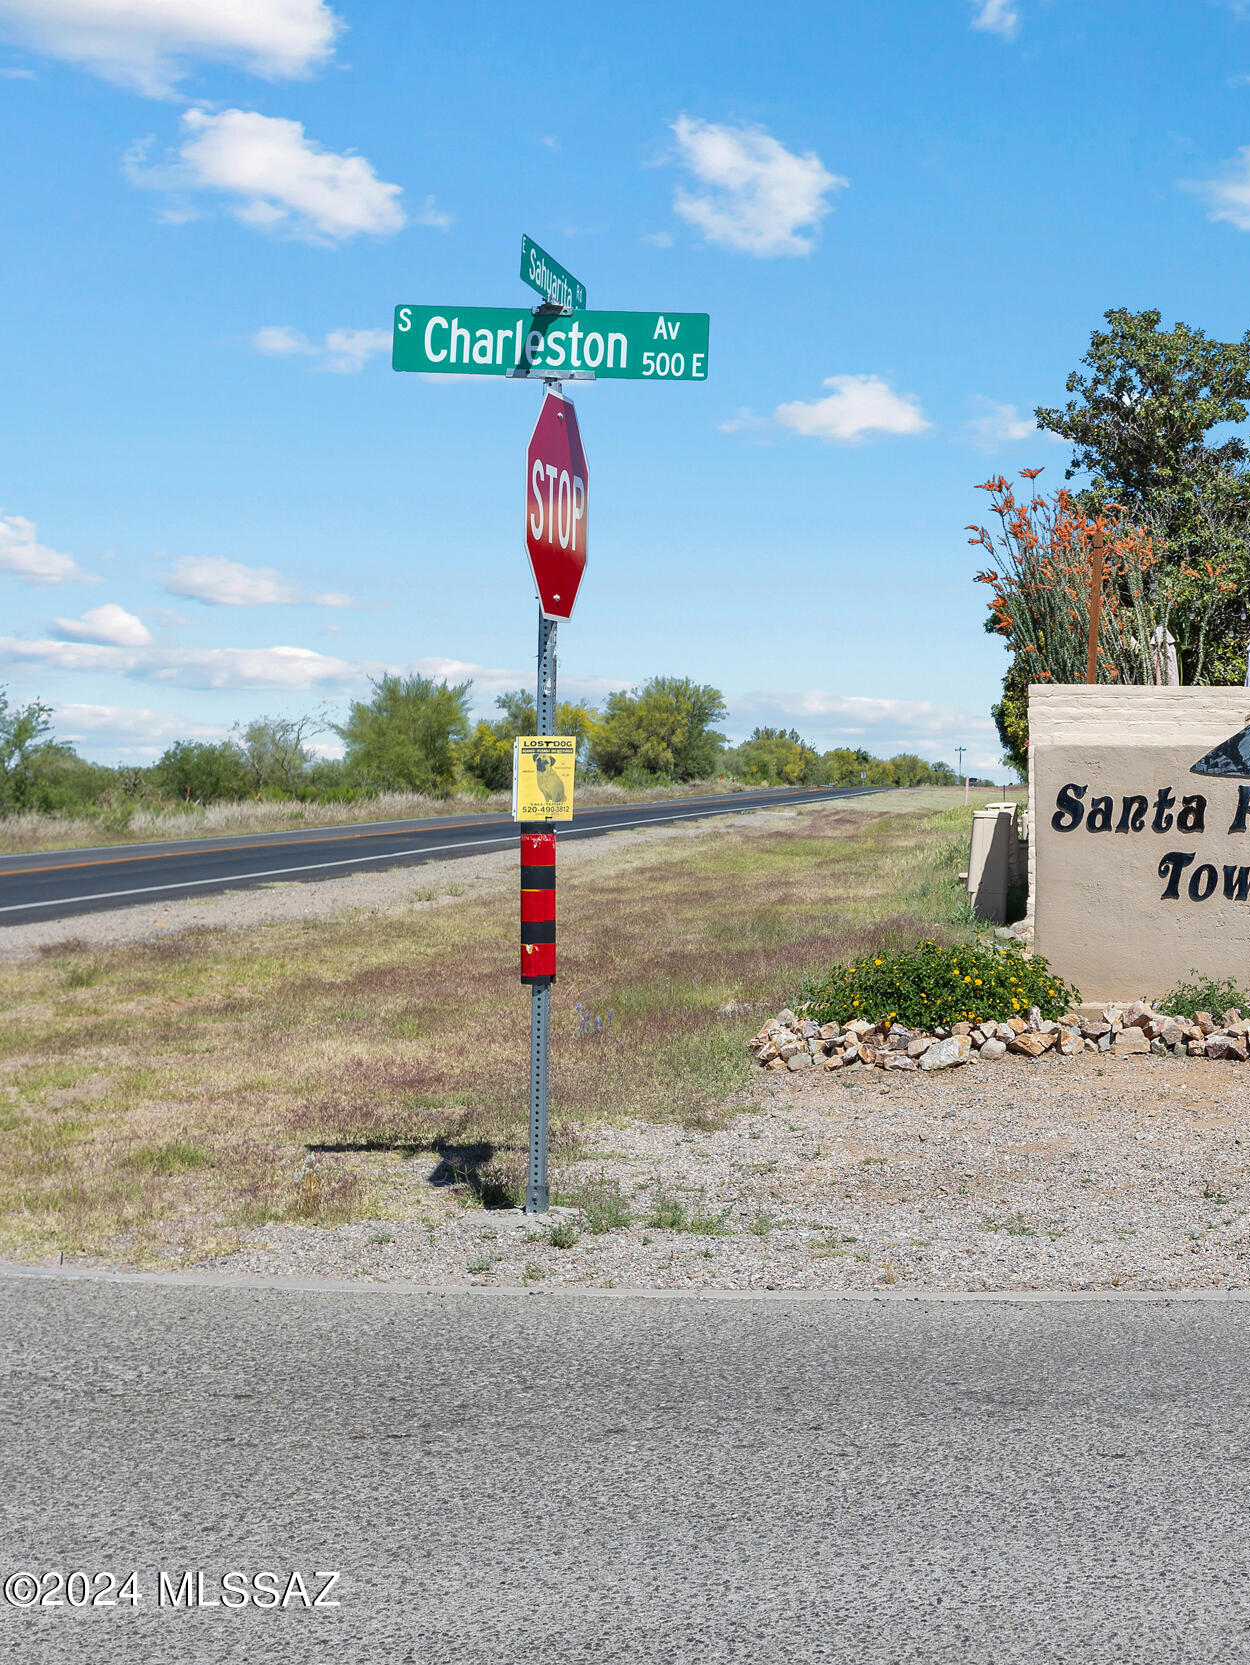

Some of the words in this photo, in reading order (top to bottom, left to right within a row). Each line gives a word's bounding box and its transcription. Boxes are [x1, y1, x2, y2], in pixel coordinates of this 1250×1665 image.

[529, 248, 573, 308] Sahuarita
[398, 308, 412, 332] S
[424, 315, 628, 368] Charleston
[653, 316, 681, 341] Av
[642, 352, 685, 377] 500
[691, 353, 705, 378] E
[530, 458, 585, 551] STOP
[1051, 783, 1207, 834] Santa
